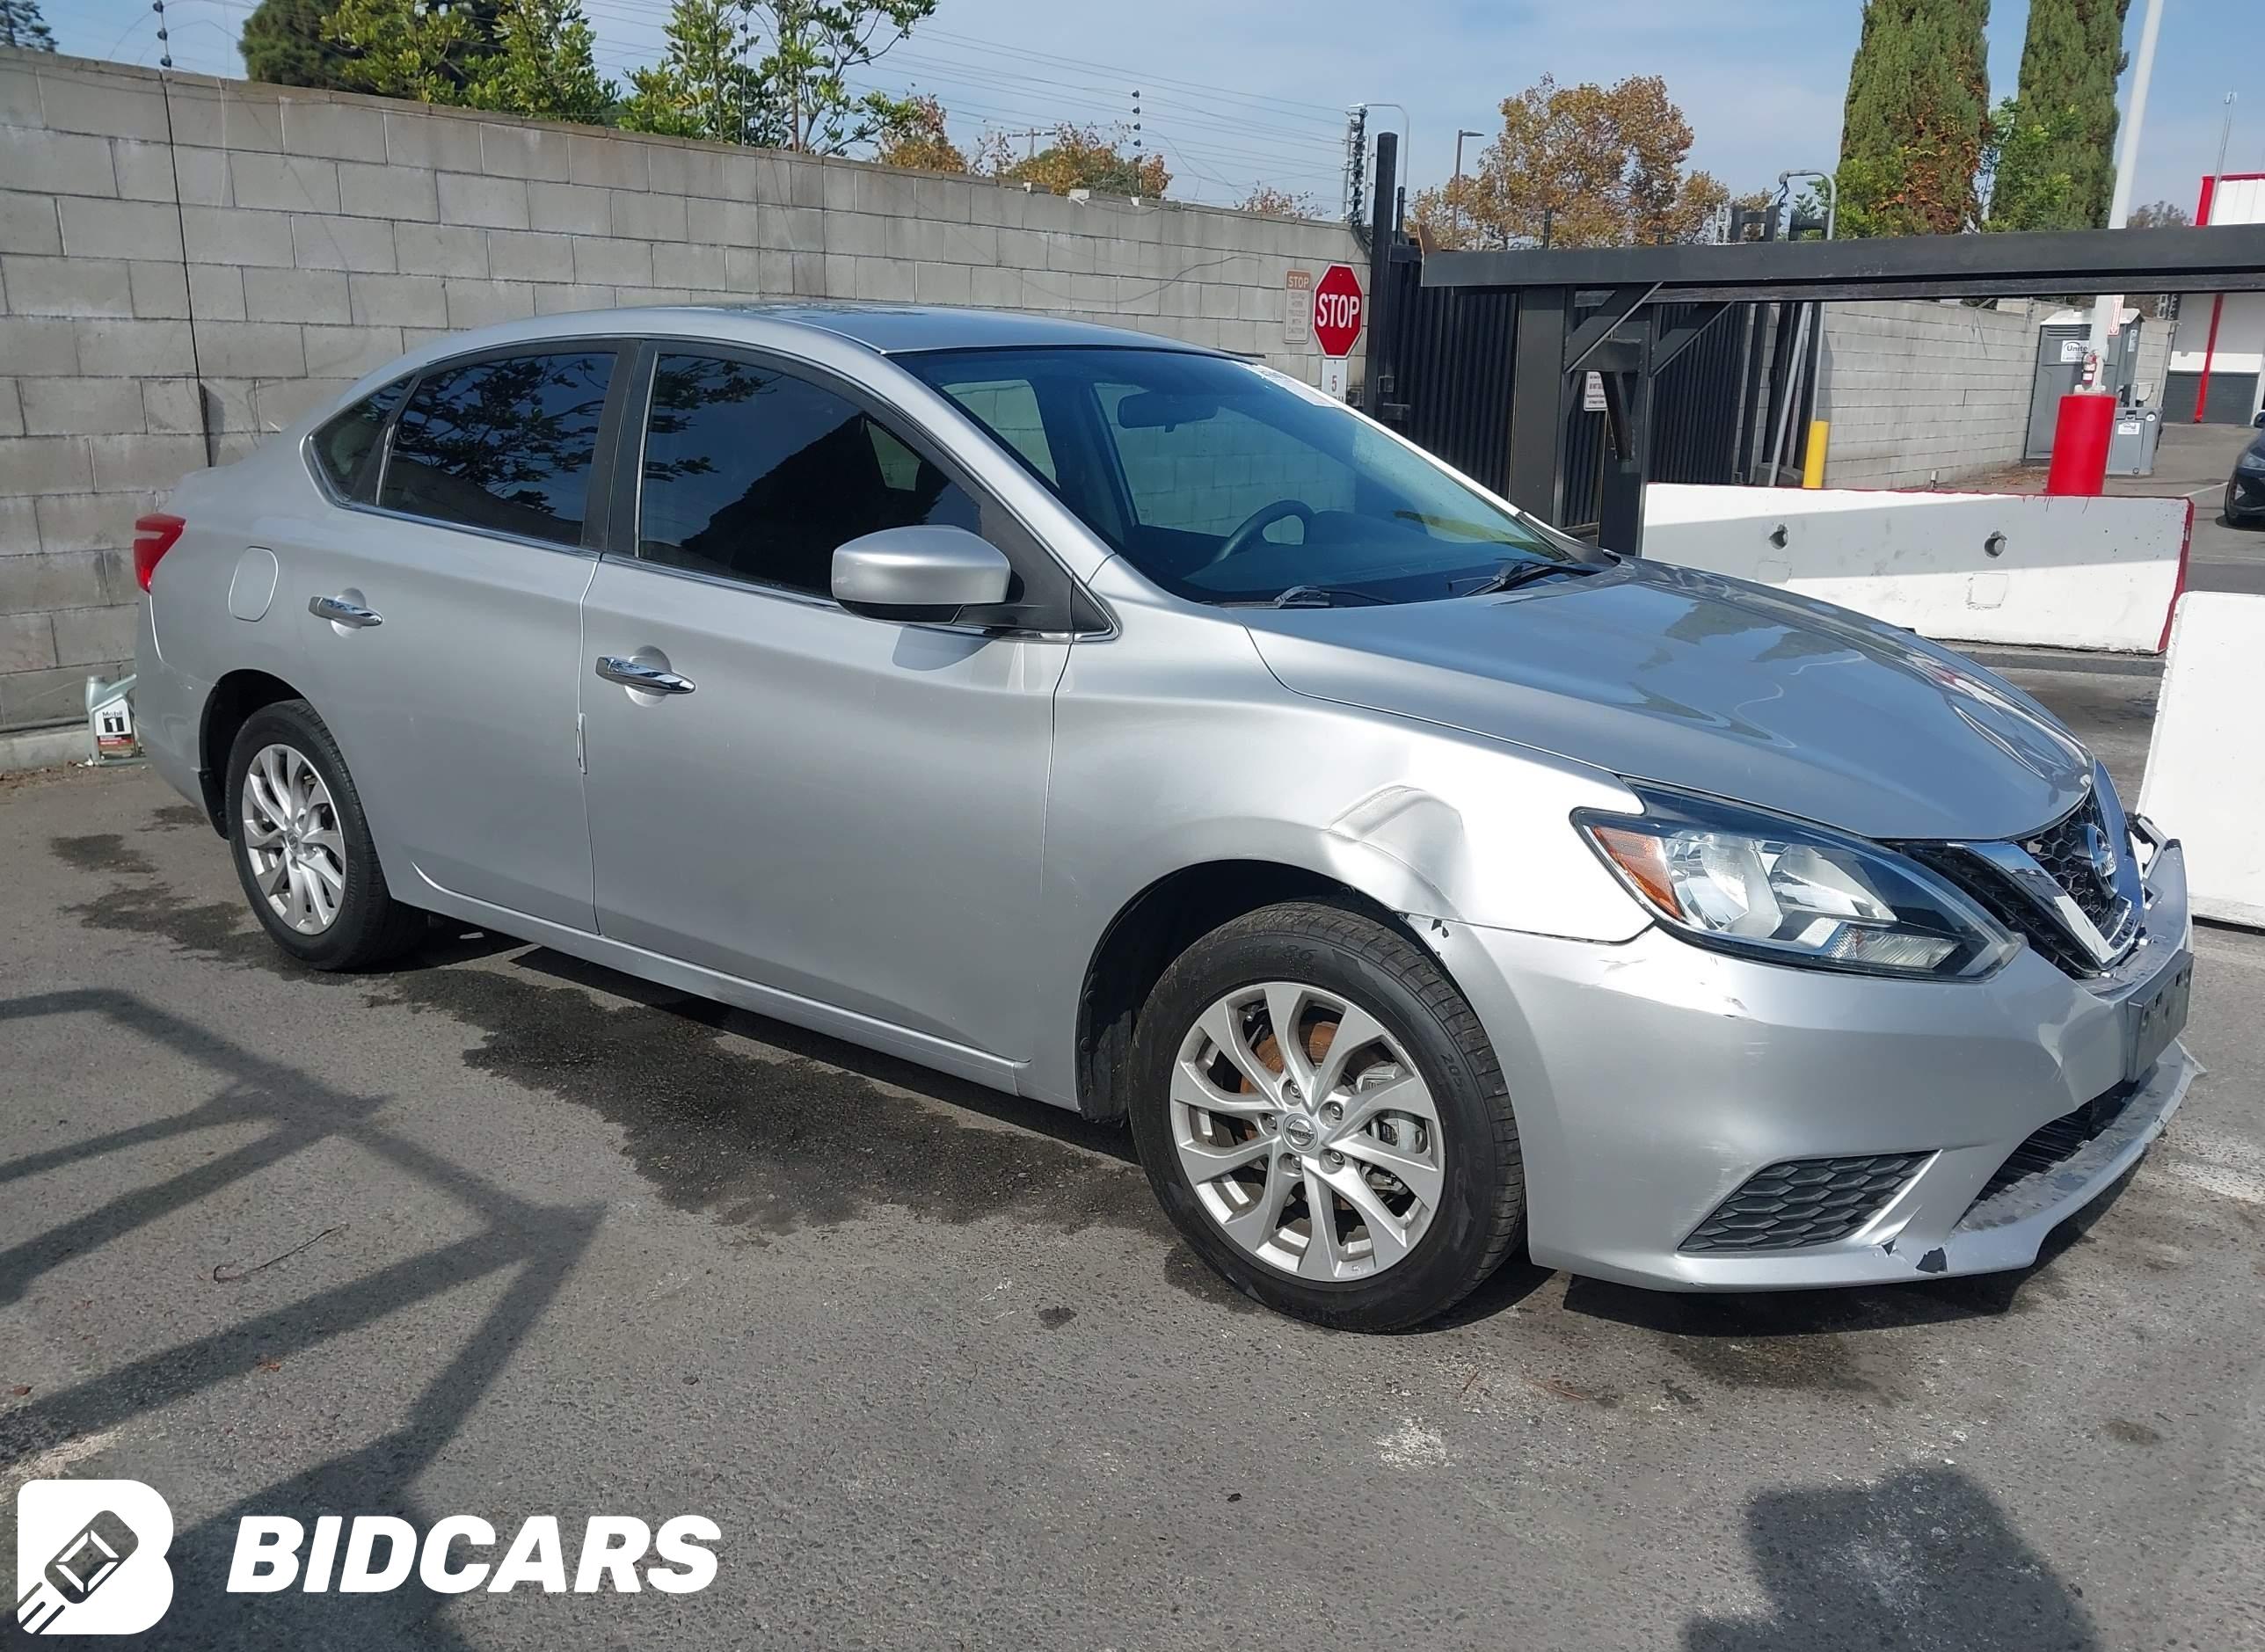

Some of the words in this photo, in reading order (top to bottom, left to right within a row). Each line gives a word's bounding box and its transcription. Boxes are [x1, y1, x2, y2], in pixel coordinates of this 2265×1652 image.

[1288, 276, 1309, 288] STOP
[1316, 293, 1359, 329] STOP
[1331, 375, 1337, 392] 5
